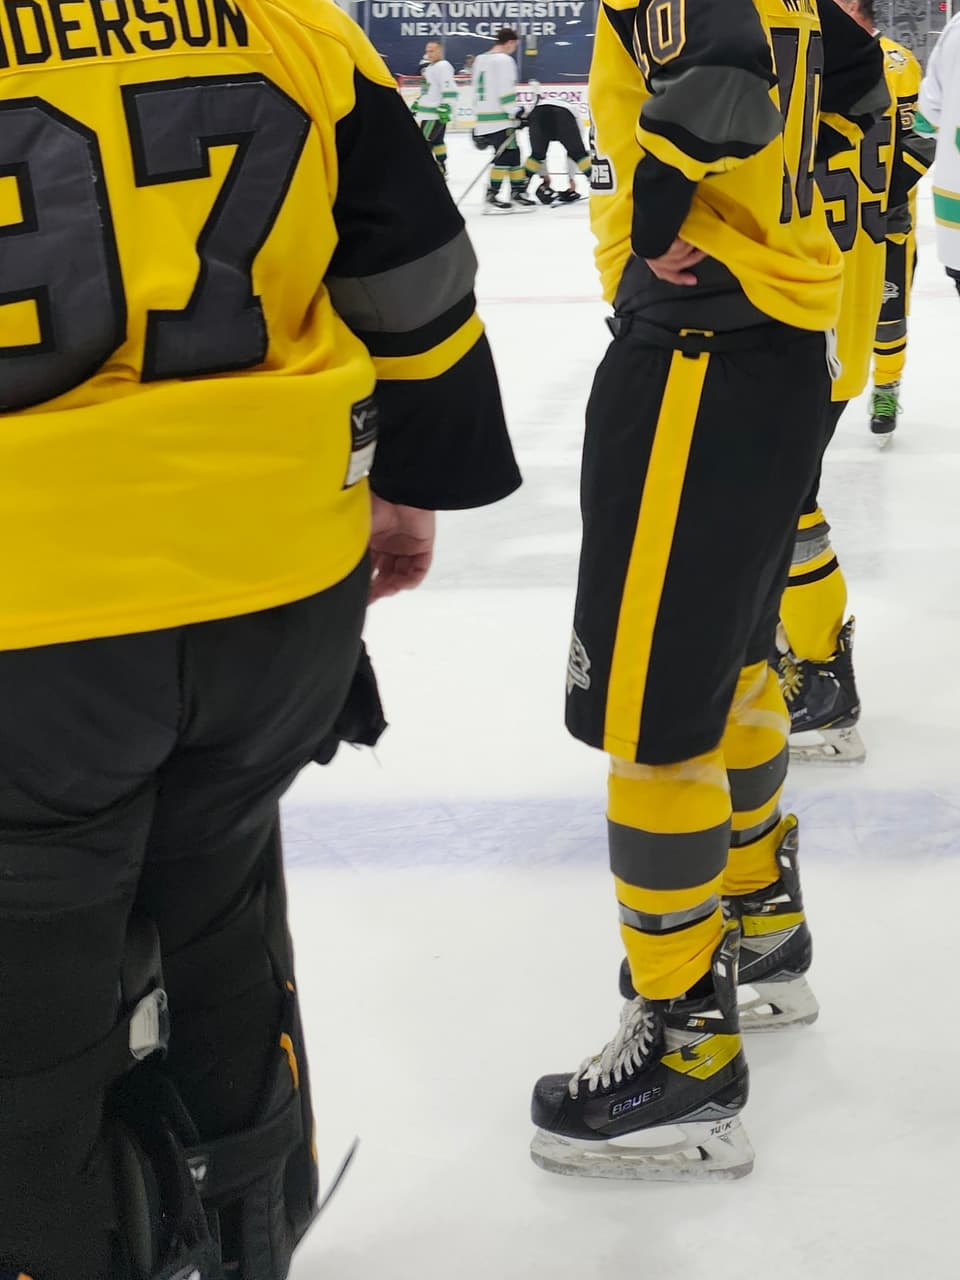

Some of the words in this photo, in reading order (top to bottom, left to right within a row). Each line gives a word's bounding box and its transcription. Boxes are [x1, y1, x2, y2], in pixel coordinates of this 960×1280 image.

[372, 2, 443, 18] UTICA
[450, 1, 585, 19] UNIVERSITY
[401, 22, 470, 36] NEXUS
[611, 1086, 662, 1116] BAUER
